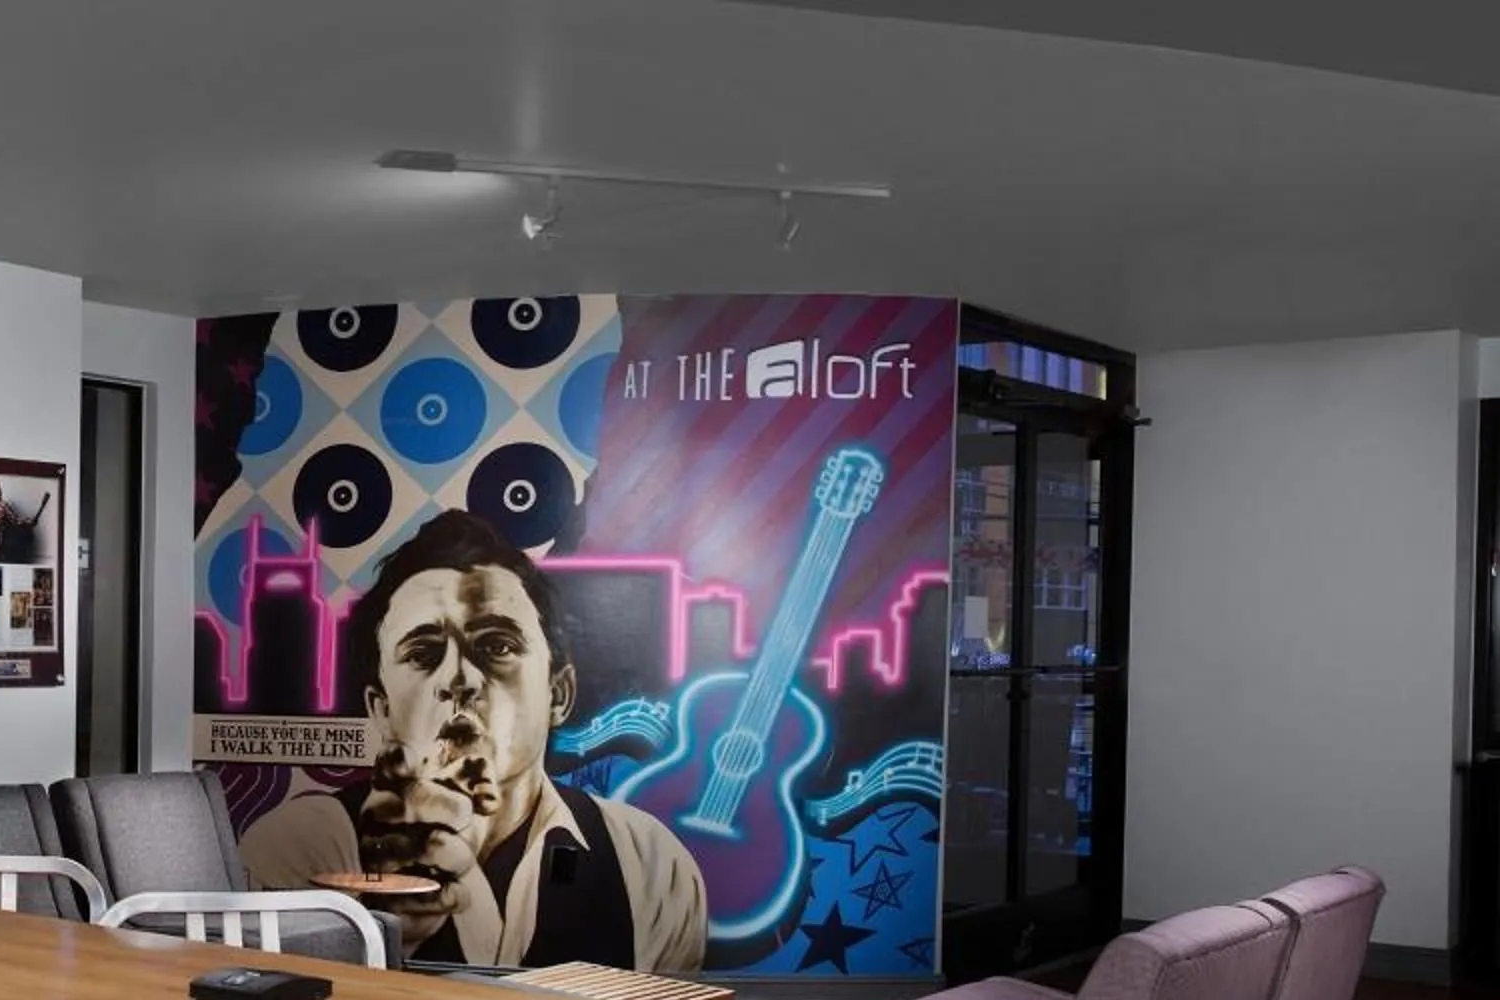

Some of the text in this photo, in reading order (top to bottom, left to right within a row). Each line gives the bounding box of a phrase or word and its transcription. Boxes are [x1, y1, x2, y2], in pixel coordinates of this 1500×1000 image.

[623, 338, 917, 401] AT THE aloft
[211, 724, 365, 743] BECAUSE YOU'RE MINE
[211, 739, 365, 759] I WALK THE LINE
